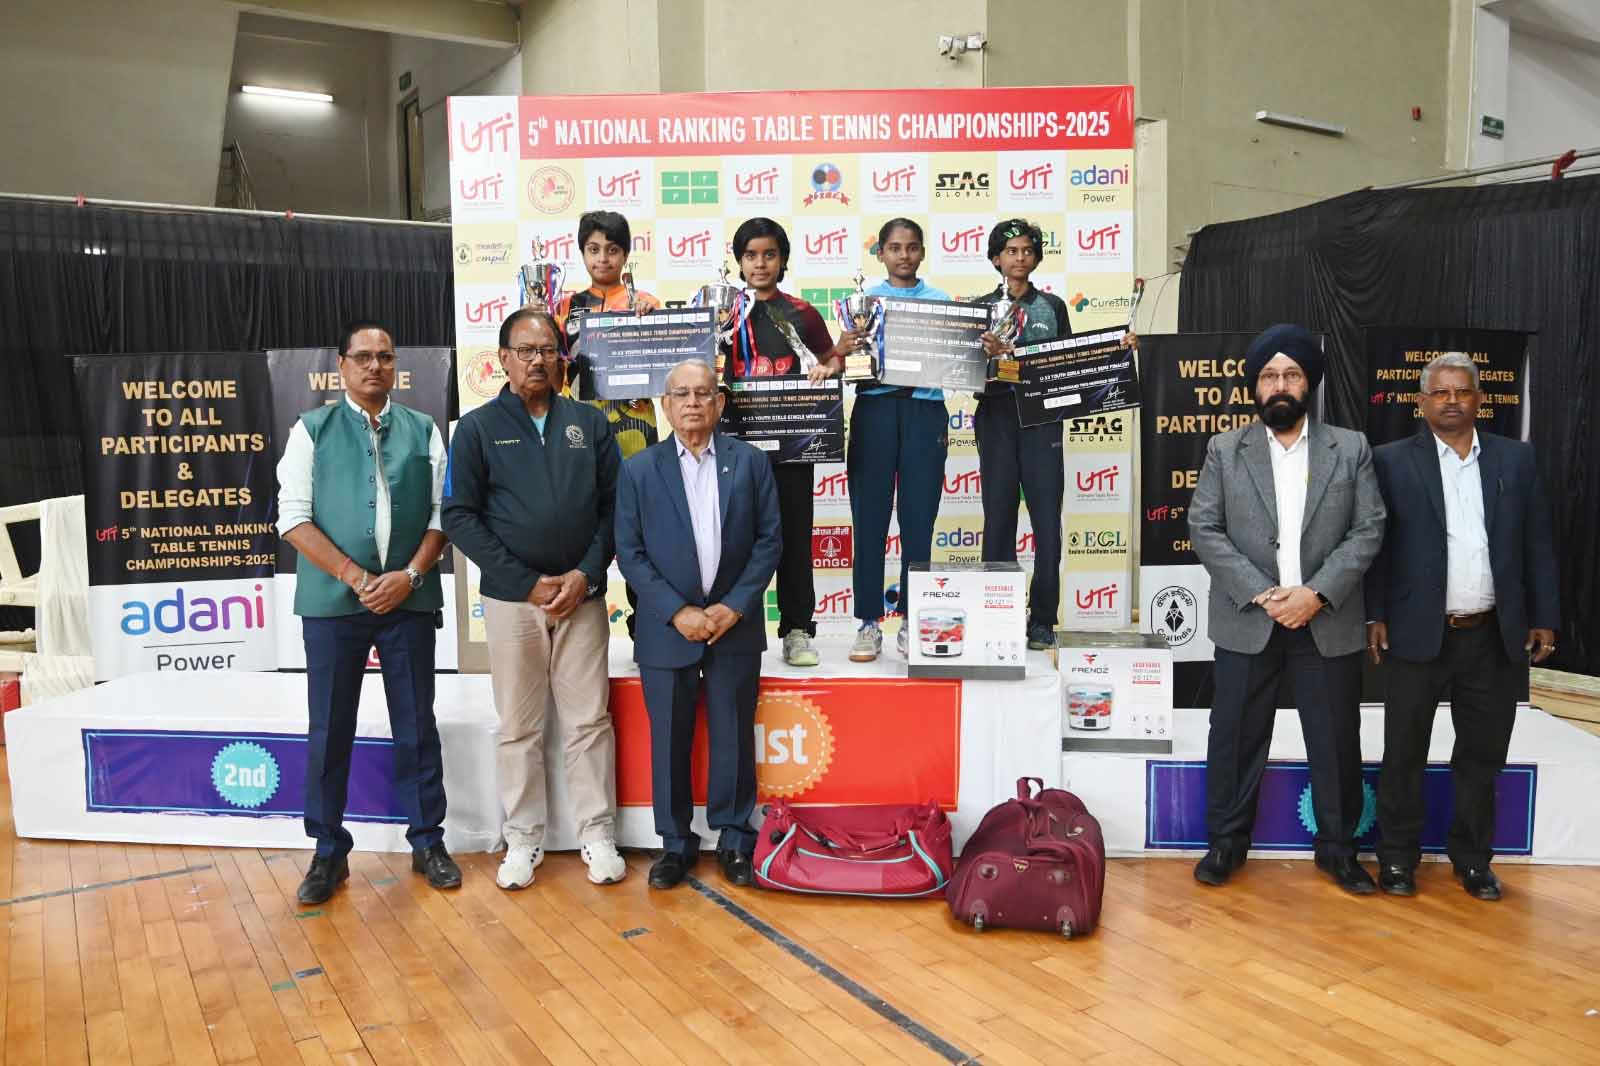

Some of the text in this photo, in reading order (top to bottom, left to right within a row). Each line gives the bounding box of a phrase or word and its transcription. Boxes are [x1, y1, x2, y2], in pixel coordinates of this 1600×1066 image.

[528, 111, 1110, 146] 5th NATIONAL RANKING TABLE TENNIS CHAMPIONSHIPS-2025
[936, 171, 990, 189] STAG
[1071, 164, 1128, 186] adani
[1083, 194, 1116, 203] Power
[1472, 351, 1489, 363] ALL
[1178, 359, 1247, 378] WELC
[1376, 368, 1515, 382] PARTICIP EGATES
[122, 380, 237, 400] WELCOME
[1194, 386, 1256, 406] TO AL
[1494, 394, 1520, 405] TENNIS
[142, 408, 222, 427] TO ALL
[1069, 416, 1122, 434] STAG
[1156, 414, 1260, 434] PARTICIP
[101, 434, 264, 455] PARTICIPANTS
[177, 462, 193, 480] &
[120, 487, 252, 509] DELEGATES
[121, 527, 136, 539] 5th
[140, 524, 211, 538] NATIONAL
[1084, 531, 1127, 547] ECL
[151, 539, 250, 554] TABLE TENNIS
[126, 554, 276, 571] CHAMPIONSHIPS-2025
[120, 583, 265, 635] adani
[1174, 627, 1192, 642] India
[156, 653, 236, 671] Power
[224, 762, 267, 788] 2nd
